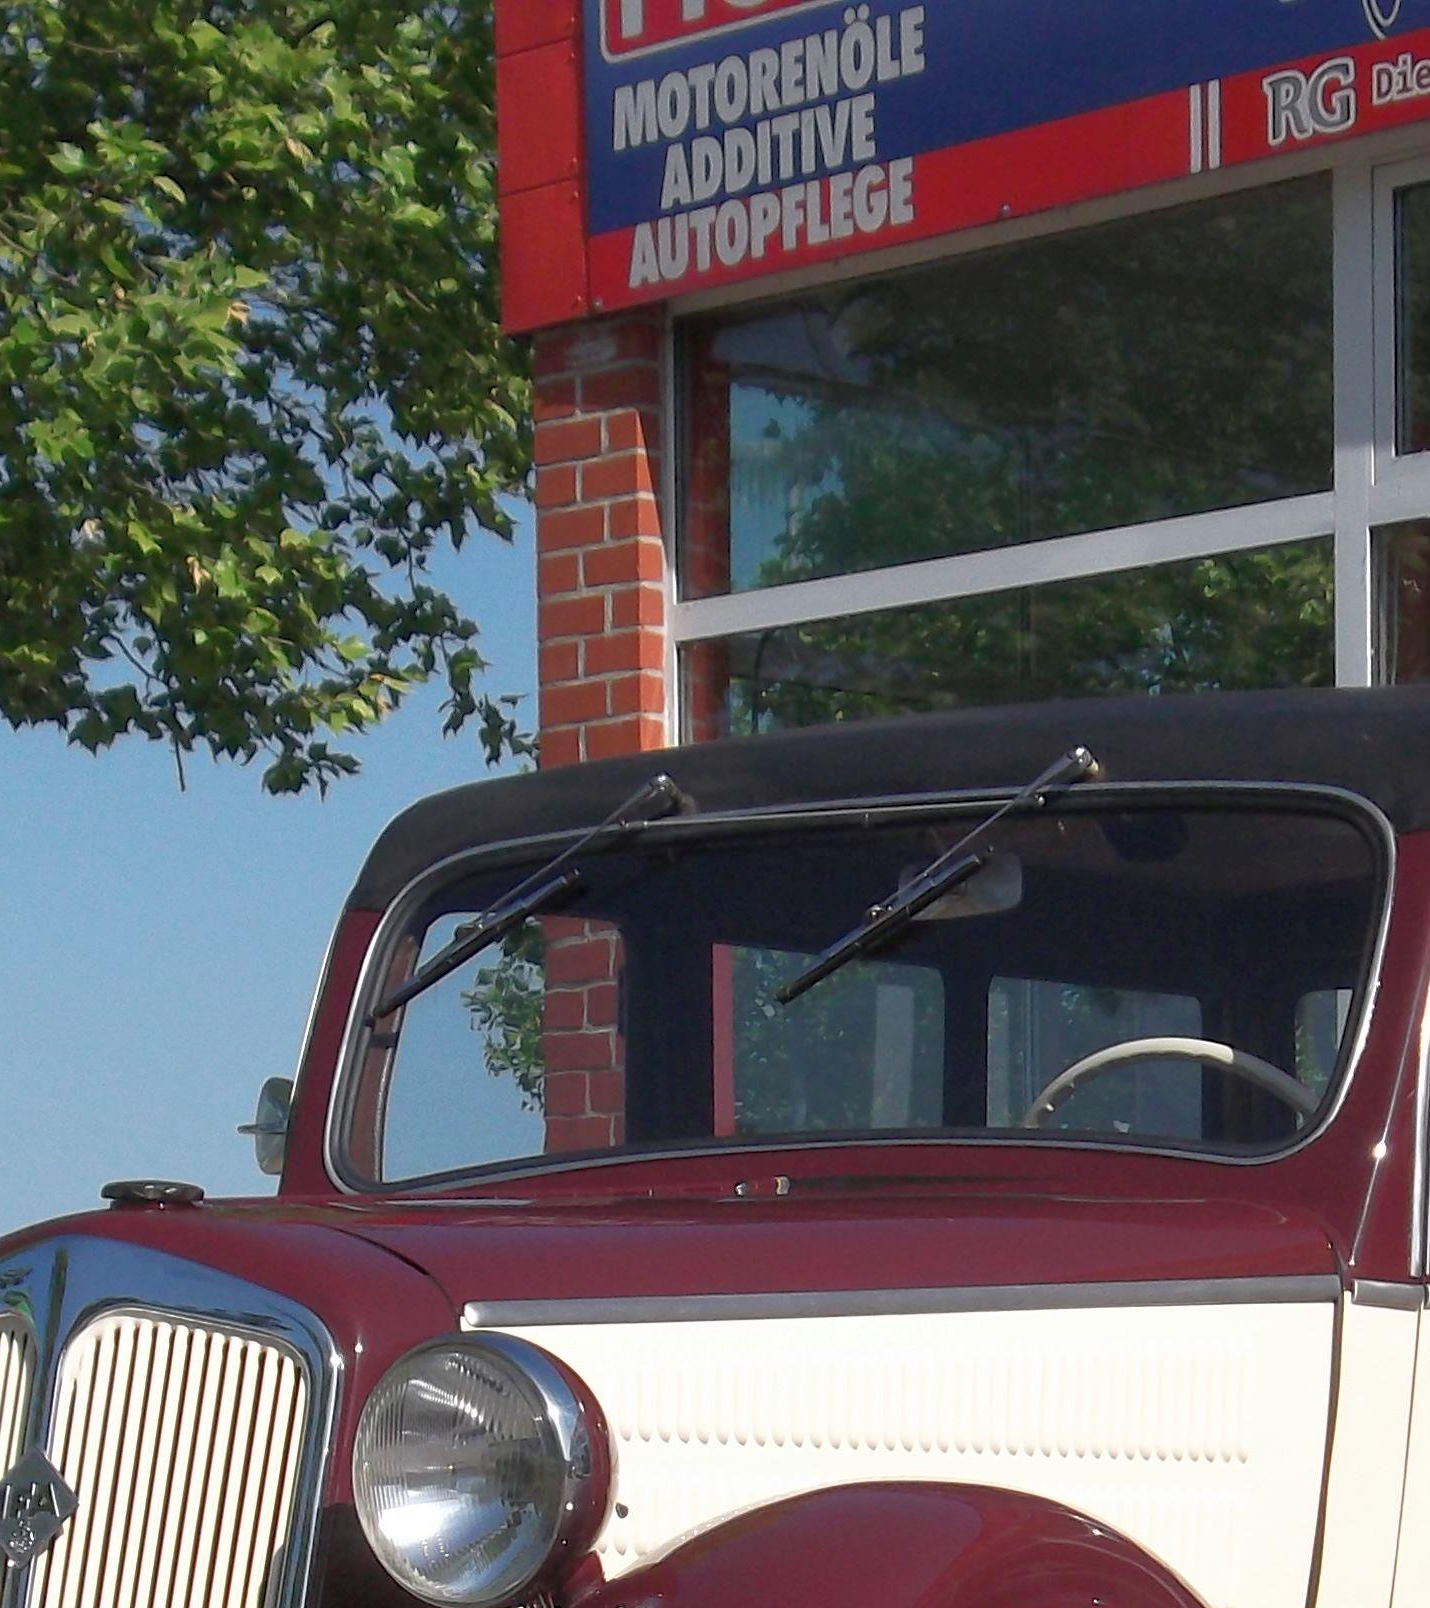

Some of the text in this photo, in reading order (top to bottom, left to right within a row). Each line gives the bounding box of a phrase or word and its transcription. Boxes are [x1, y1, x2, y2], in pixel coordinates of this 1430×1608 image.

[613, 4, 925, 151] MOTORENÖLE
[1263, 58, 1355, 145] RG
[660, 92, 876, 210] ADDITIVE
[629, 157, 914, 288] AUTOPFLEGE
